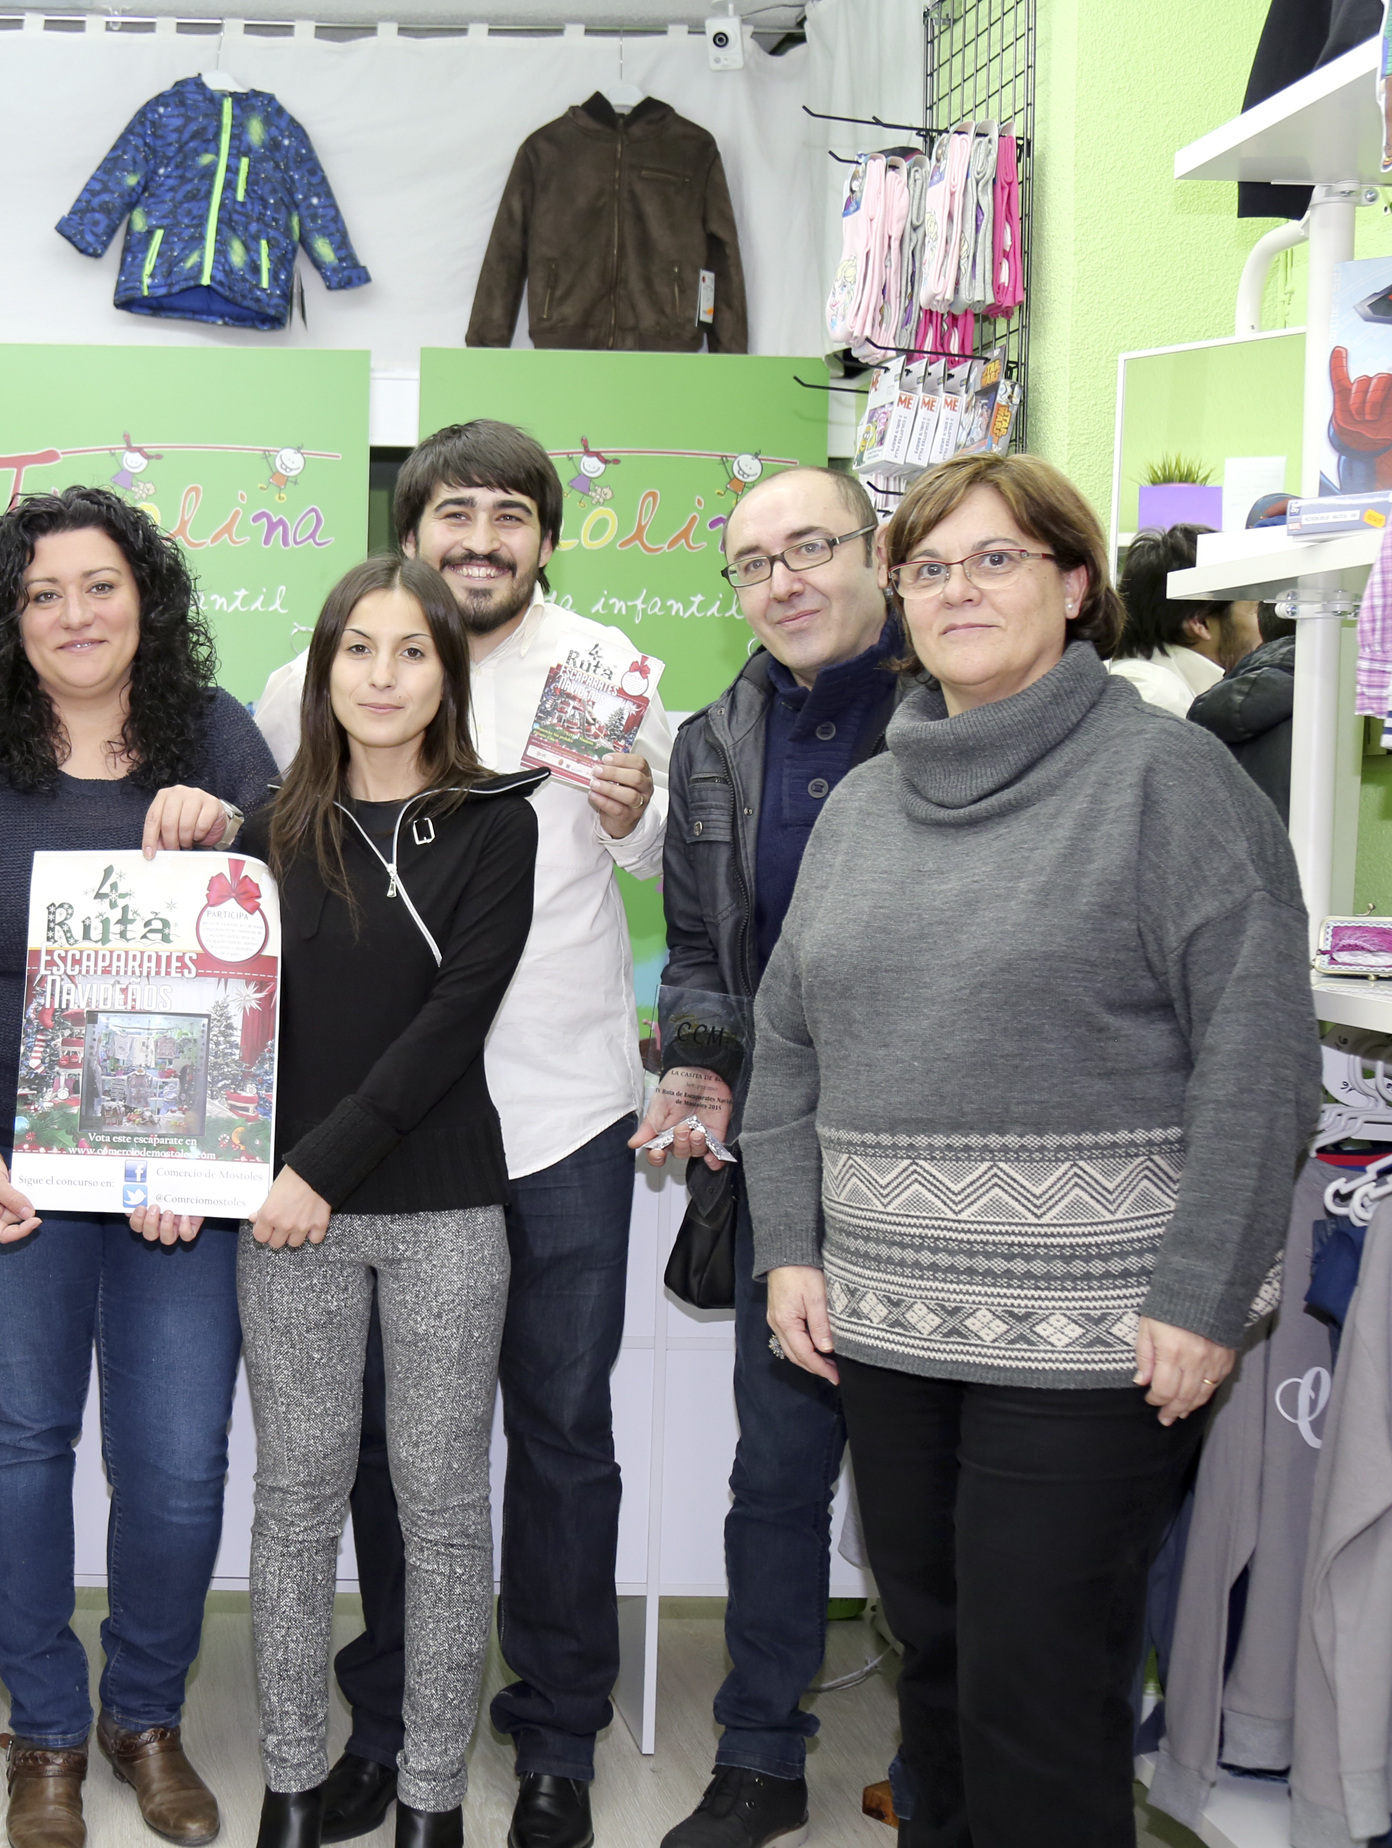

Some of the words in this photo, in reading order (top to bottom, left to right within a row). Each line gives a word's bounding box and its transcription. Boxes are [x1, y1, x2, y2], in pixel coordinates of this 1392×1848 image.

[897, 394, 914, 410] ME
[921, 396, 937, 412] ME
[943, 395, 959, 412] ME
[591, 589, 744, 624] infantil
[566, 650, 614, 681] Ruta
[559, 665, 620, 697] ESCAPARATES
[93, 864, 130, 910] 4
[206, 909, 249, 920] PARTICIPA
[46, 902, 175, 947] Ruta
[39, 941, 198, 978] ESCAPARATES
[45, 974, 173, 1012] NAVIDEÑOS
[677, 1021, 725, 1047] CCM
[680, 1071, 703, 1080] CASITA
[88, 1133, 111, 1143] Vota
[112, 1135, 132, 1143] este
[133, 1135, 184, 1147] escaparate
[185, 1137, 197, 1146] en
[68, 1146, 216, 1160] www.comerciodemostoles.com
[18, 1175, 44, 1187] Sigue
[46, 1176, 54, 1185] el
[56, 1178, 99, 1187] concurso
[101, 1180, 115, 1188] en:
[156, 1167, 203, 1178] Comercio
[204, 1169, 217, 1179] de
